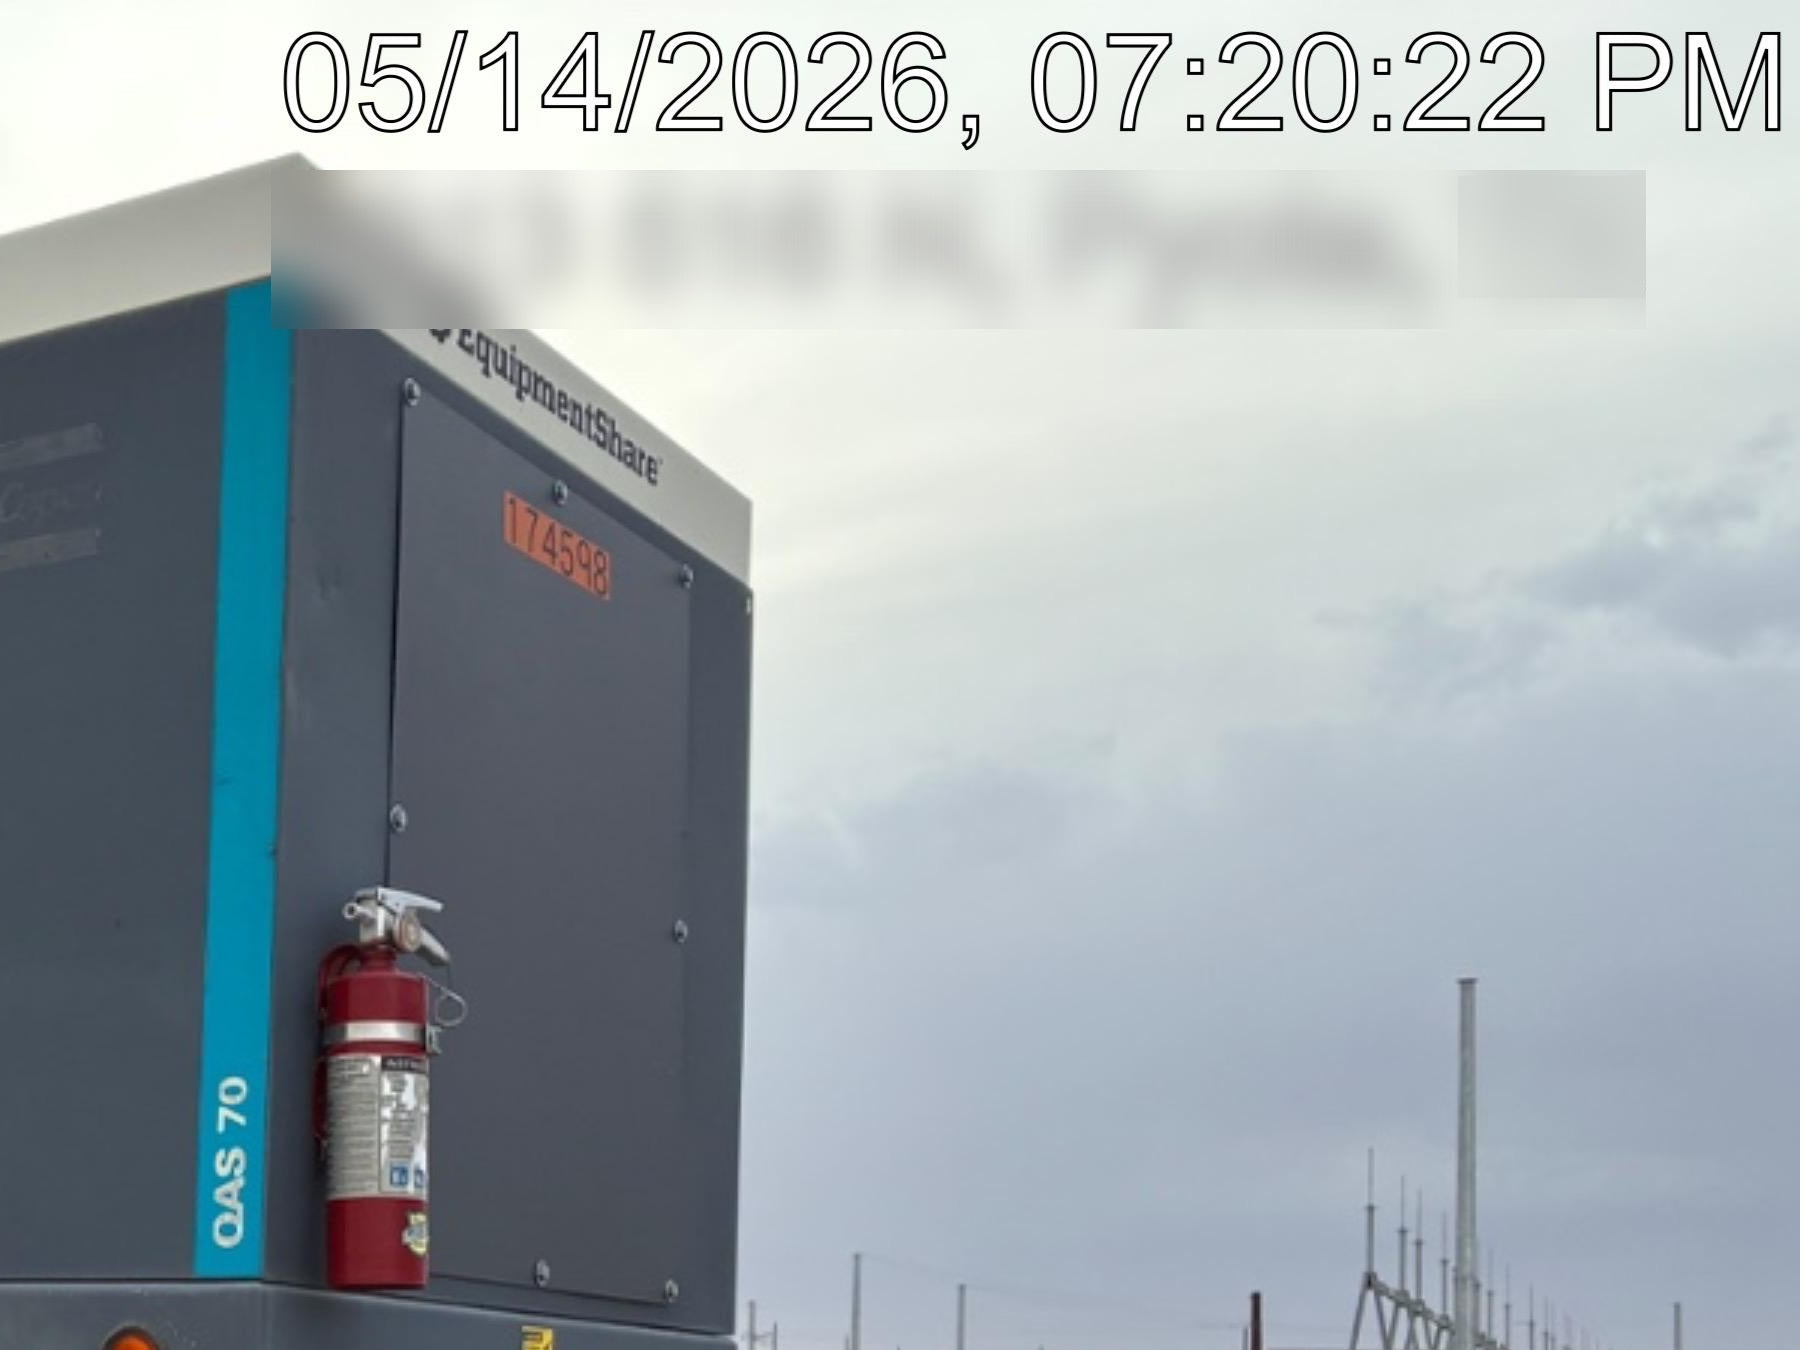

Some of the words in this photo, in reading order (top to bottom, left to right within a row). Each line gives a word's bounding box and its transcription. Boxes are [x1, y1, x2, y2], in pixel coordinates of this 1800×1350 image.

[454, 329, 659, 486] EquipmentShare
[508, 498, 608, 597] 174598
[218, 1075, 248, 1134] 70
[212, 1147, 247, 1249] QAS
